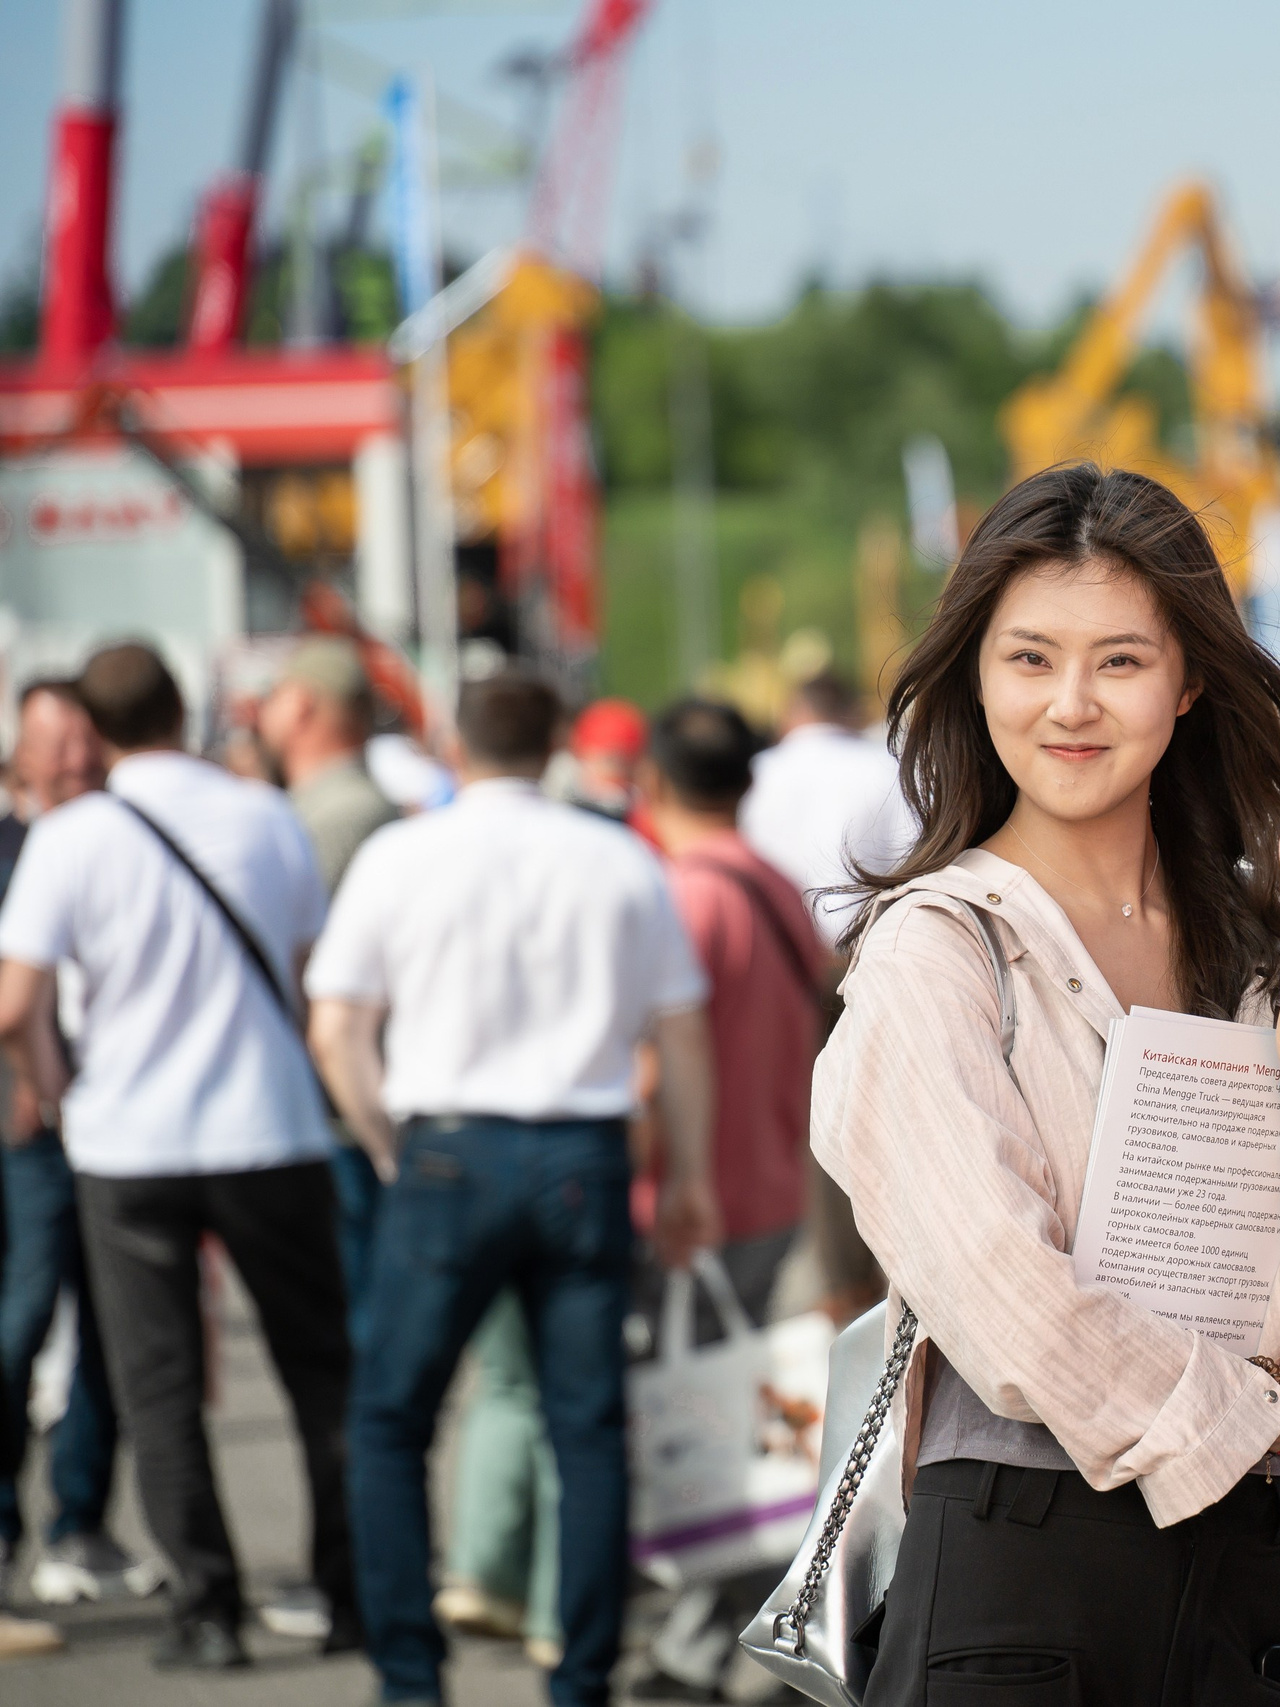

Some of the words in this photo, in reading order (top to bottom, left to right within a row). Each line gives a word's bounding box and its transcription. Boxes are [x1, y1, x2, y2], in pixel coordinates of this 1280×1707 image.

[1143, 1049, 1198, 1067] Китайская
[1200, 1059, 1249, 1074] компания
[1139, 1066, 1198, 1083] Председатель
[1200, 1077, 1227, 1087] совета
[1227, 1081, 1274, 1093] директоров:
[1136, 1083, 1161, 1095] China
[1162, 1086, 1197, 1101] Mengge
[1199, 1091, 1220, 1103] Truck
[1232, 1098, 1264, 1109] ведущая
[1133, 1098, 1178, 1112] компания,
[1180, 1105, 1266, 1122] специализирующаяся
[1130, 1112, 1197, 1128] исключительно
[1199, 1121, 1210, 1129] на
[1211, 1123, 1246, 1134] продаже
[1124, 1139, 1178, 1153] самосвалов.
[1127, 1125, 1179, 1140] грузовиков,
[1181, 1133, 1229, 1145] самосвалов
[1238, 1140, 1277, 1151] карьерных
[1122, 1151, 1135, 1161] На
[1136, 1155, 1183, 1168] китайском
[1184, 1162, 1211, 1172] рынке
[1213, 1165, 1226, 1173] мы
[1119, 1166, 1173, 1180] занимаемся
[1175, 1174, 1238, 1188] подержанными
[1116, 1180, 1176, 1194] самосвалами
[1176, 1189, 1194, 1198] уже
[1195, 1189, 1206, 1199] 23
[1207, 1192, 1227, 1202] года.
[1113, 1191, 1120, 1200] В
[1121, 1195, 1161, 1206] наличии
[1174, 1200, 1200, 1212] более
[1201, 1203, 1217, 1214] 600
[1217, 1207, 1246, 1219] единиц
[1107, 1220, 1141, 1231] горных
[1143, 1225, 1196, 1239] самосвалов.
[1110, 1207, 1189, 1224] ширококолейных
[1191, 1218, 1234, 1230] карьерных
[1235, 1223, 1276, 1234] самосвалов
[1106, 1231, 1133, 1244] Также
[1135, 1238, 1171, 1249] имеется
[1173, 1241, 1199, 1253] более
[1201, 1245, 1220, 1256] 1000
[1221, 1249, 1249, 1260] единиц
[1101, 1247, 1166, 1263] подержанных
[1166, 1256, 1212, 1268] дорожных
[1212, 1262, 1256, 1273] самосвалов.
[1098, 1259, 1145, 1273] Компания
[1147, 1268, 1206, 1281] осуществляет
[1207, 1275, 1237, 1287] экспорт
[1238, 1278, 1270, 1289] грузовых
[1095, 1274, 1157, 1289] автомобилей
[1167, 1284, 1207, 1295] запасных
[1208, 1289, 1233, 1298] частей
[1233, 1292, 1247, 1300] для
[1179, 1313, 1193, 1322] мы
[1194, 1315, 1231, 1325] являемся
[1206, 1330, 1246, 1342] карьерных
